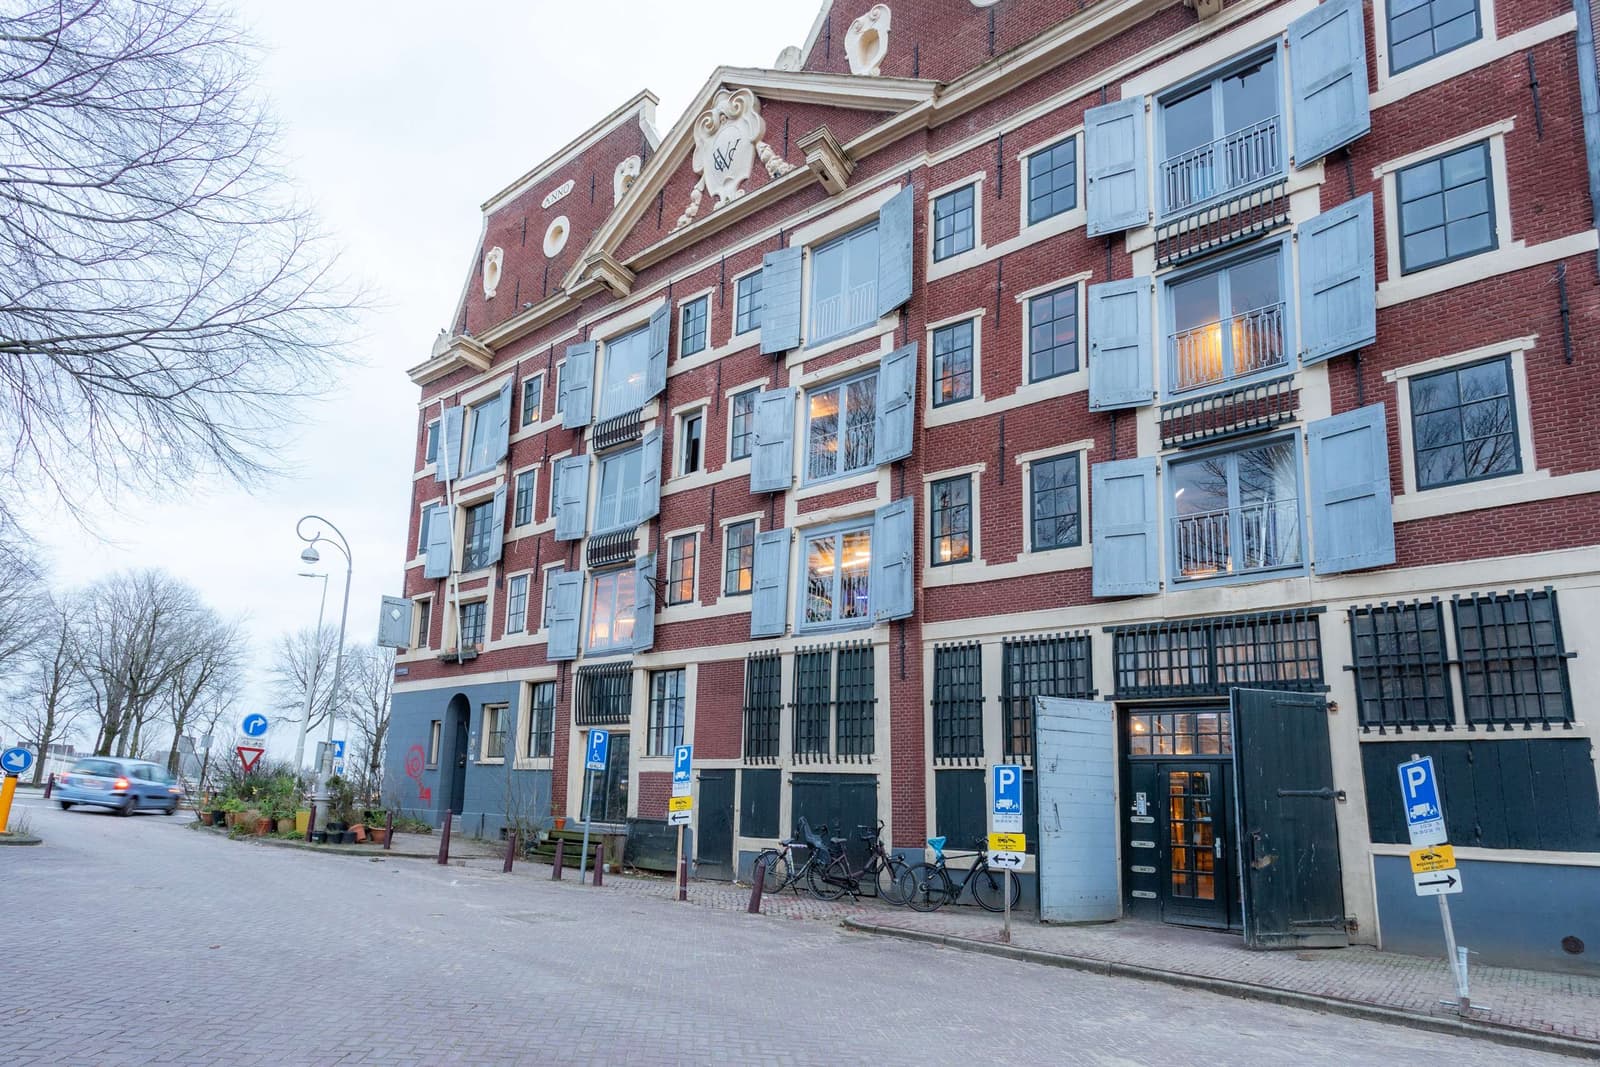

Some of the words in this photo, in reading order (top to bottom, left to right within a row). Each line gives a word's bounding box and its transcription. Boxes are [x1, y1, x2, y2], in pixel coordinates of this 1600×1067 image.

[543, 183, 571, 208] ANNO
[592, 731, 605, 749] P
[677, 748, 688, 768] P
[999, 769, 1015, 794] P
[1407, 766, 1426, 799] P
